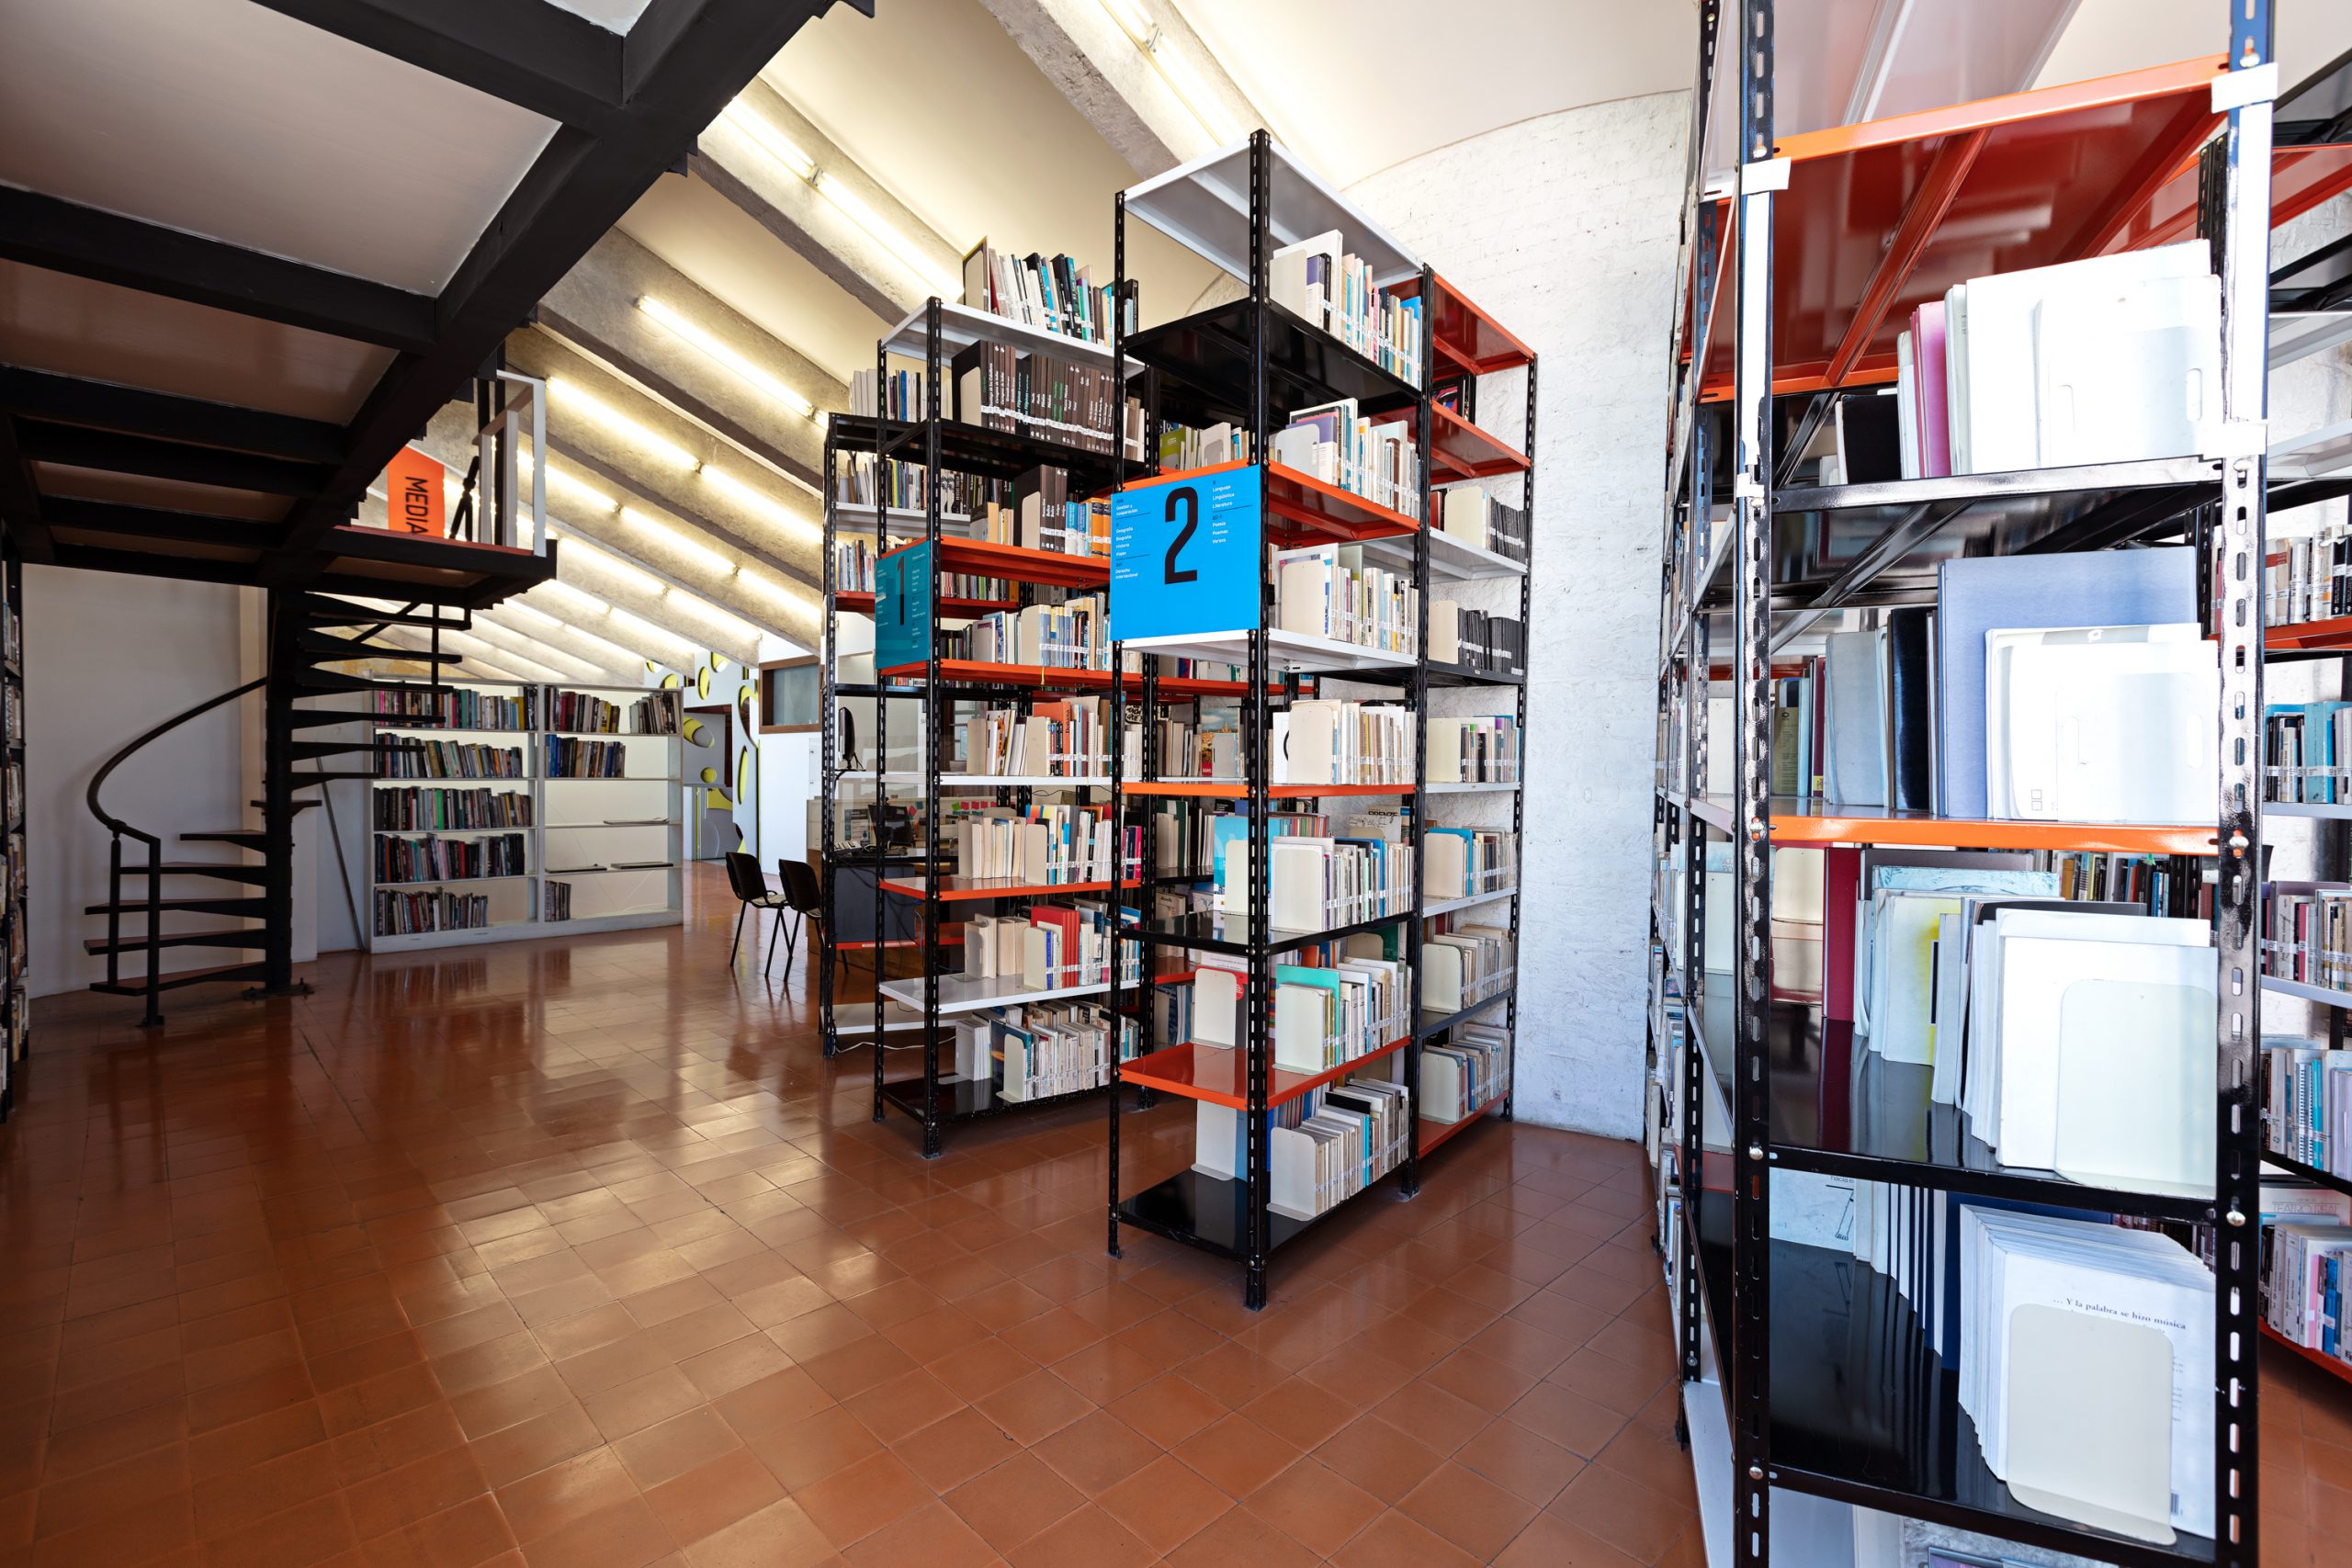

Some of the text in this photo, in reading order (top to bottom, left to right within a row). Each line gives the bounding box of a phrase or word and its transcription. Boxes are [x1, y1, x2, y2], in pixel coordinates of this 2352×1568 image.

[405, 477, 429, 534] MEDIA
[1165, 486, 1198, 585] 2
[897, 556, 905, 626] 1
[2075, 1300, 2083, 1308] la
[2086, 1303, 2118, 1315] palabra
[2132, 1312, 2152, 1322] hizo
[2154, 1318, 2187, 1330] música
